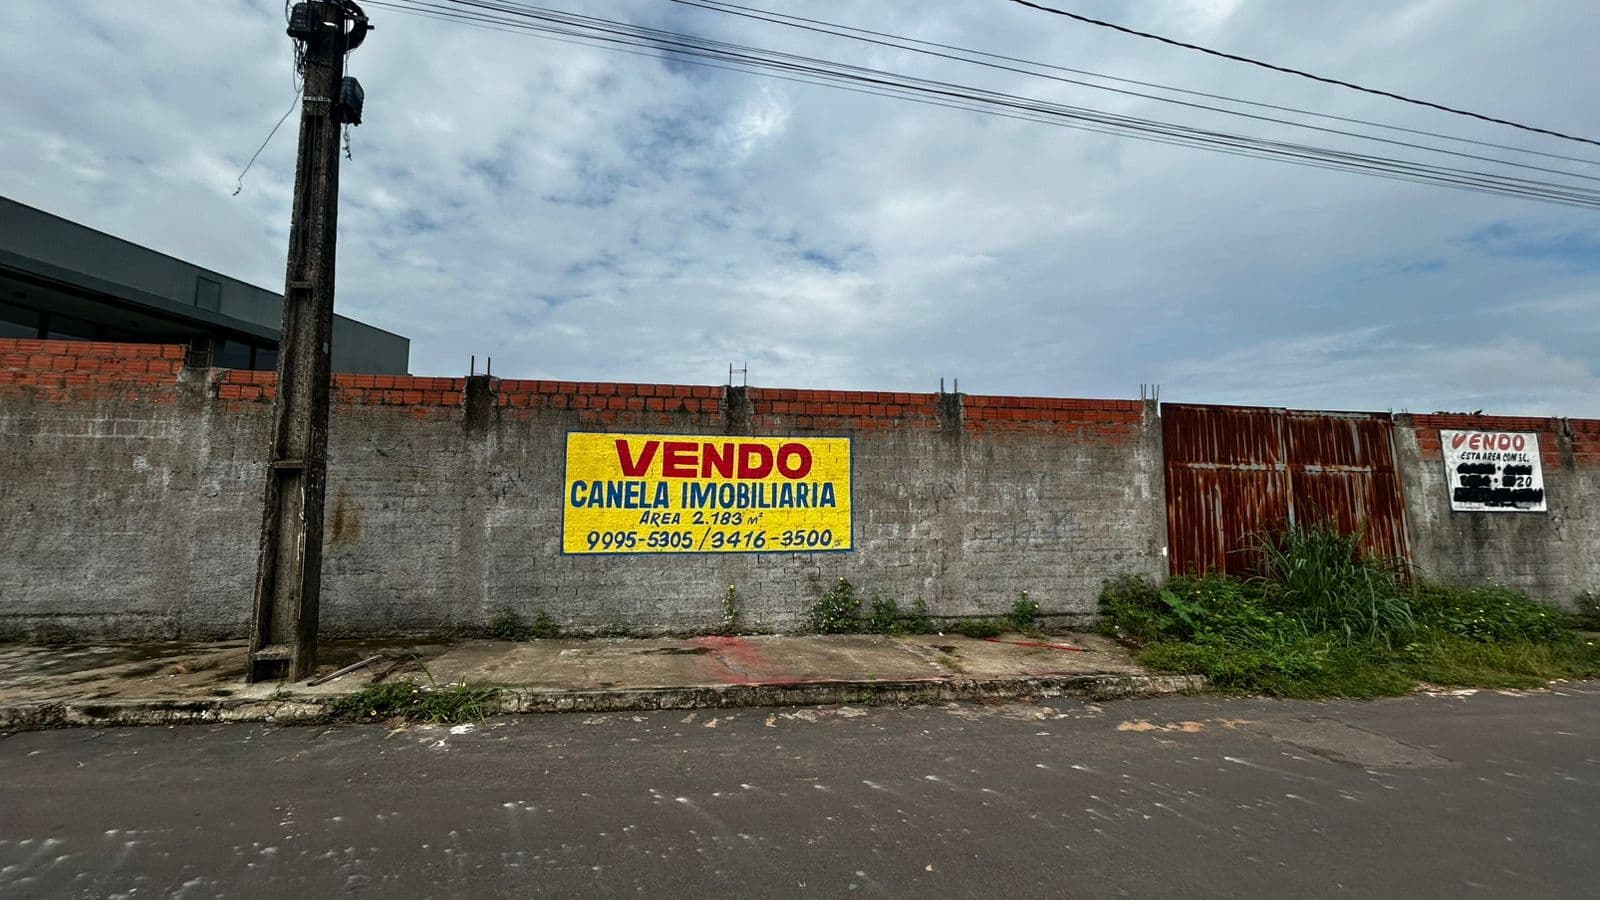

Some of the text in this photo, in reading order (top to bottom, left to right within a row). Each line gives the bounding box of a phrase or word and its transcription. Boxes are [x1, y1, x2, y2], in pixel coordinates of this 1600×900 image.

[1451, 433, 1525, 451] VENDO
[615, 439, 813, 479] VENDO
[1461, 451, 1481, 460] ESTA
[570, 480, 836, 509] CANELA IMOBILIARIA
[692, 512, 743, 525] 2.183
